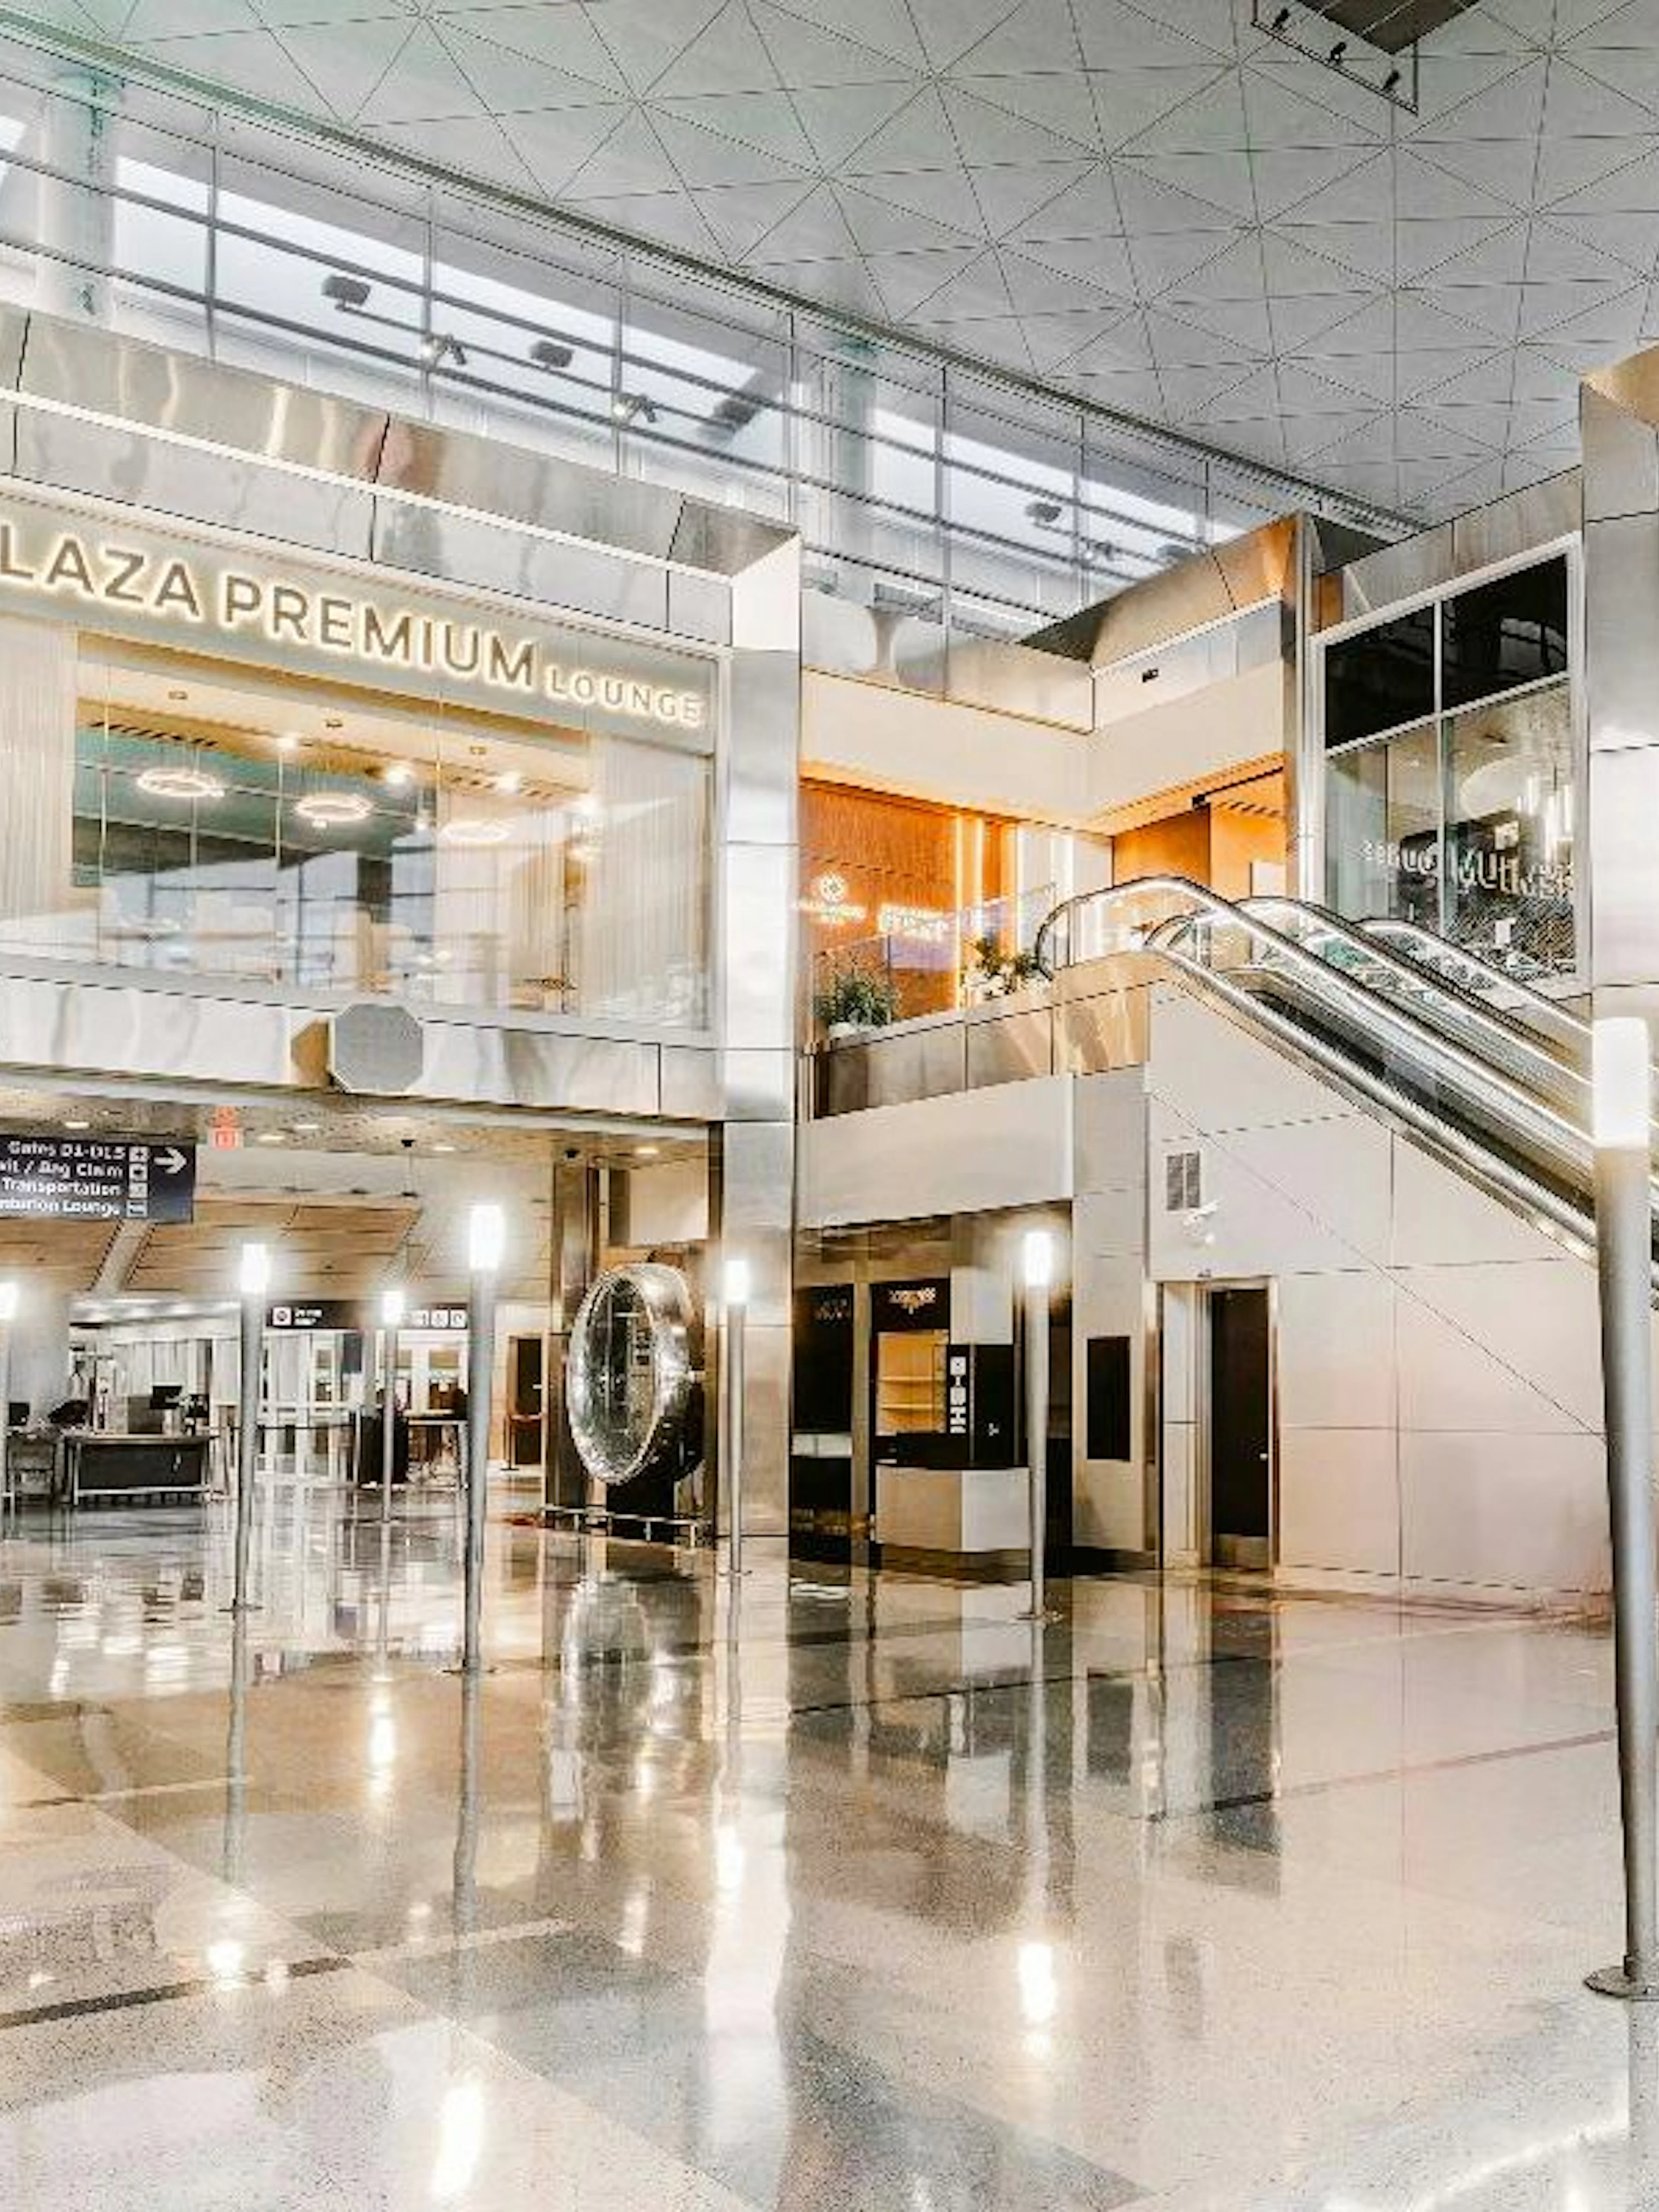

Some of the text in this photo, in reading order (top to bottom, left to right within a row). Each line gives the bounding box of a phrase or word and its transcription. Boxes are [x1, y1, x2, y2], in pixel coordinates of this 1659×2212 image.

[0, 524, 702, 723] LAZA PREMIUM LOUNGE
[8, 1141, 57, 1157] Gates
[76, 1162, 123, 1178] Claim
[1, 1176, 121, 1196] Transportation
